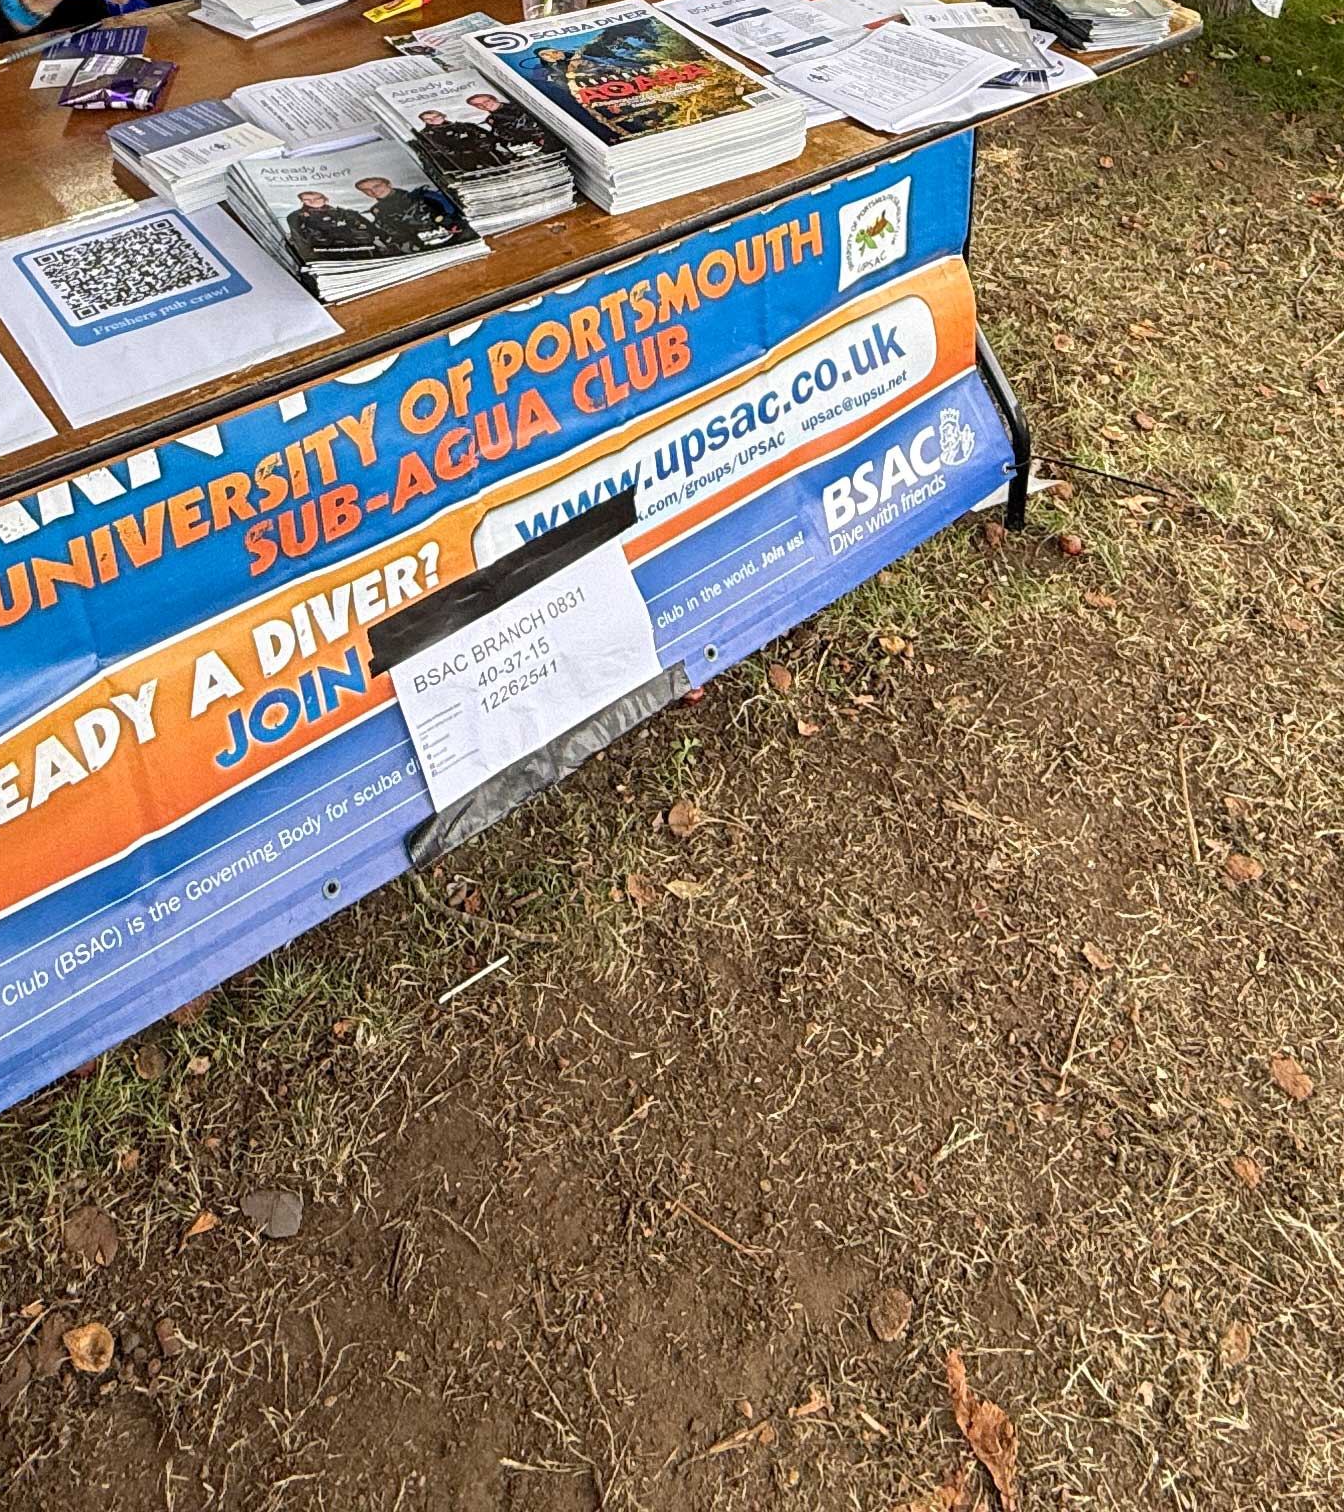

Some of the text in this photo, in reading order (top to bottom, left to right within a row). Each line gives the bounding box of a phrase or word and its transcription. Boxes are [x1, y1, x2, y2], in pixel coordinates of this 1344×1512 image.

[531, 8, 649, 41] SCUBA DIVER
[687, 2, 721, 16] BSAC
[392, 79, 455, 99] Already a
[398, 80, 477, 104] scuba diver?
[578, 62, 714, 105] AQABA
[260, 164, 328, 176] Already a
[264, 168, 352, 183] scuba diver?
[92, 285, 231, 338] Freshers pub crawl
[399, 359, 474, 435] OF
[488, 210, 824, 395] PORTSMOUTH
[515, 322, 907, 543] www.upsac.co.uk
[800, 368, 909, 433] upsac@upsu.net
[244, 324, 692, 577] SUB-AQUA CLUB
[822, 425, 942, 534] BSAC
[829, 474, 947, 556] Dive with friends
[656, 531, 805, 630] club in the world. Join us!
[190, 650, 246, 719] A
[251, 541, 441, 678] DIVER?
[413, 585, 587, 695] BSAC BRANCH 0831
[476, 636, 552, 690] 40-37-15
[479, 658, 559, 715] 12262541
[214, 640, 370, 769] JOIN
[0, 965, 50, 1008] Club
[53, 924, 124, 981] (BSAC)
[126, 915, 146, 935] is
[148, 894, 182, 922] the
[185, 838, 280, 901] Governing
[277, 812, 323, 849] Body
[324, 794, 350, 823] for
[352, 765, 403, 806] scuba
